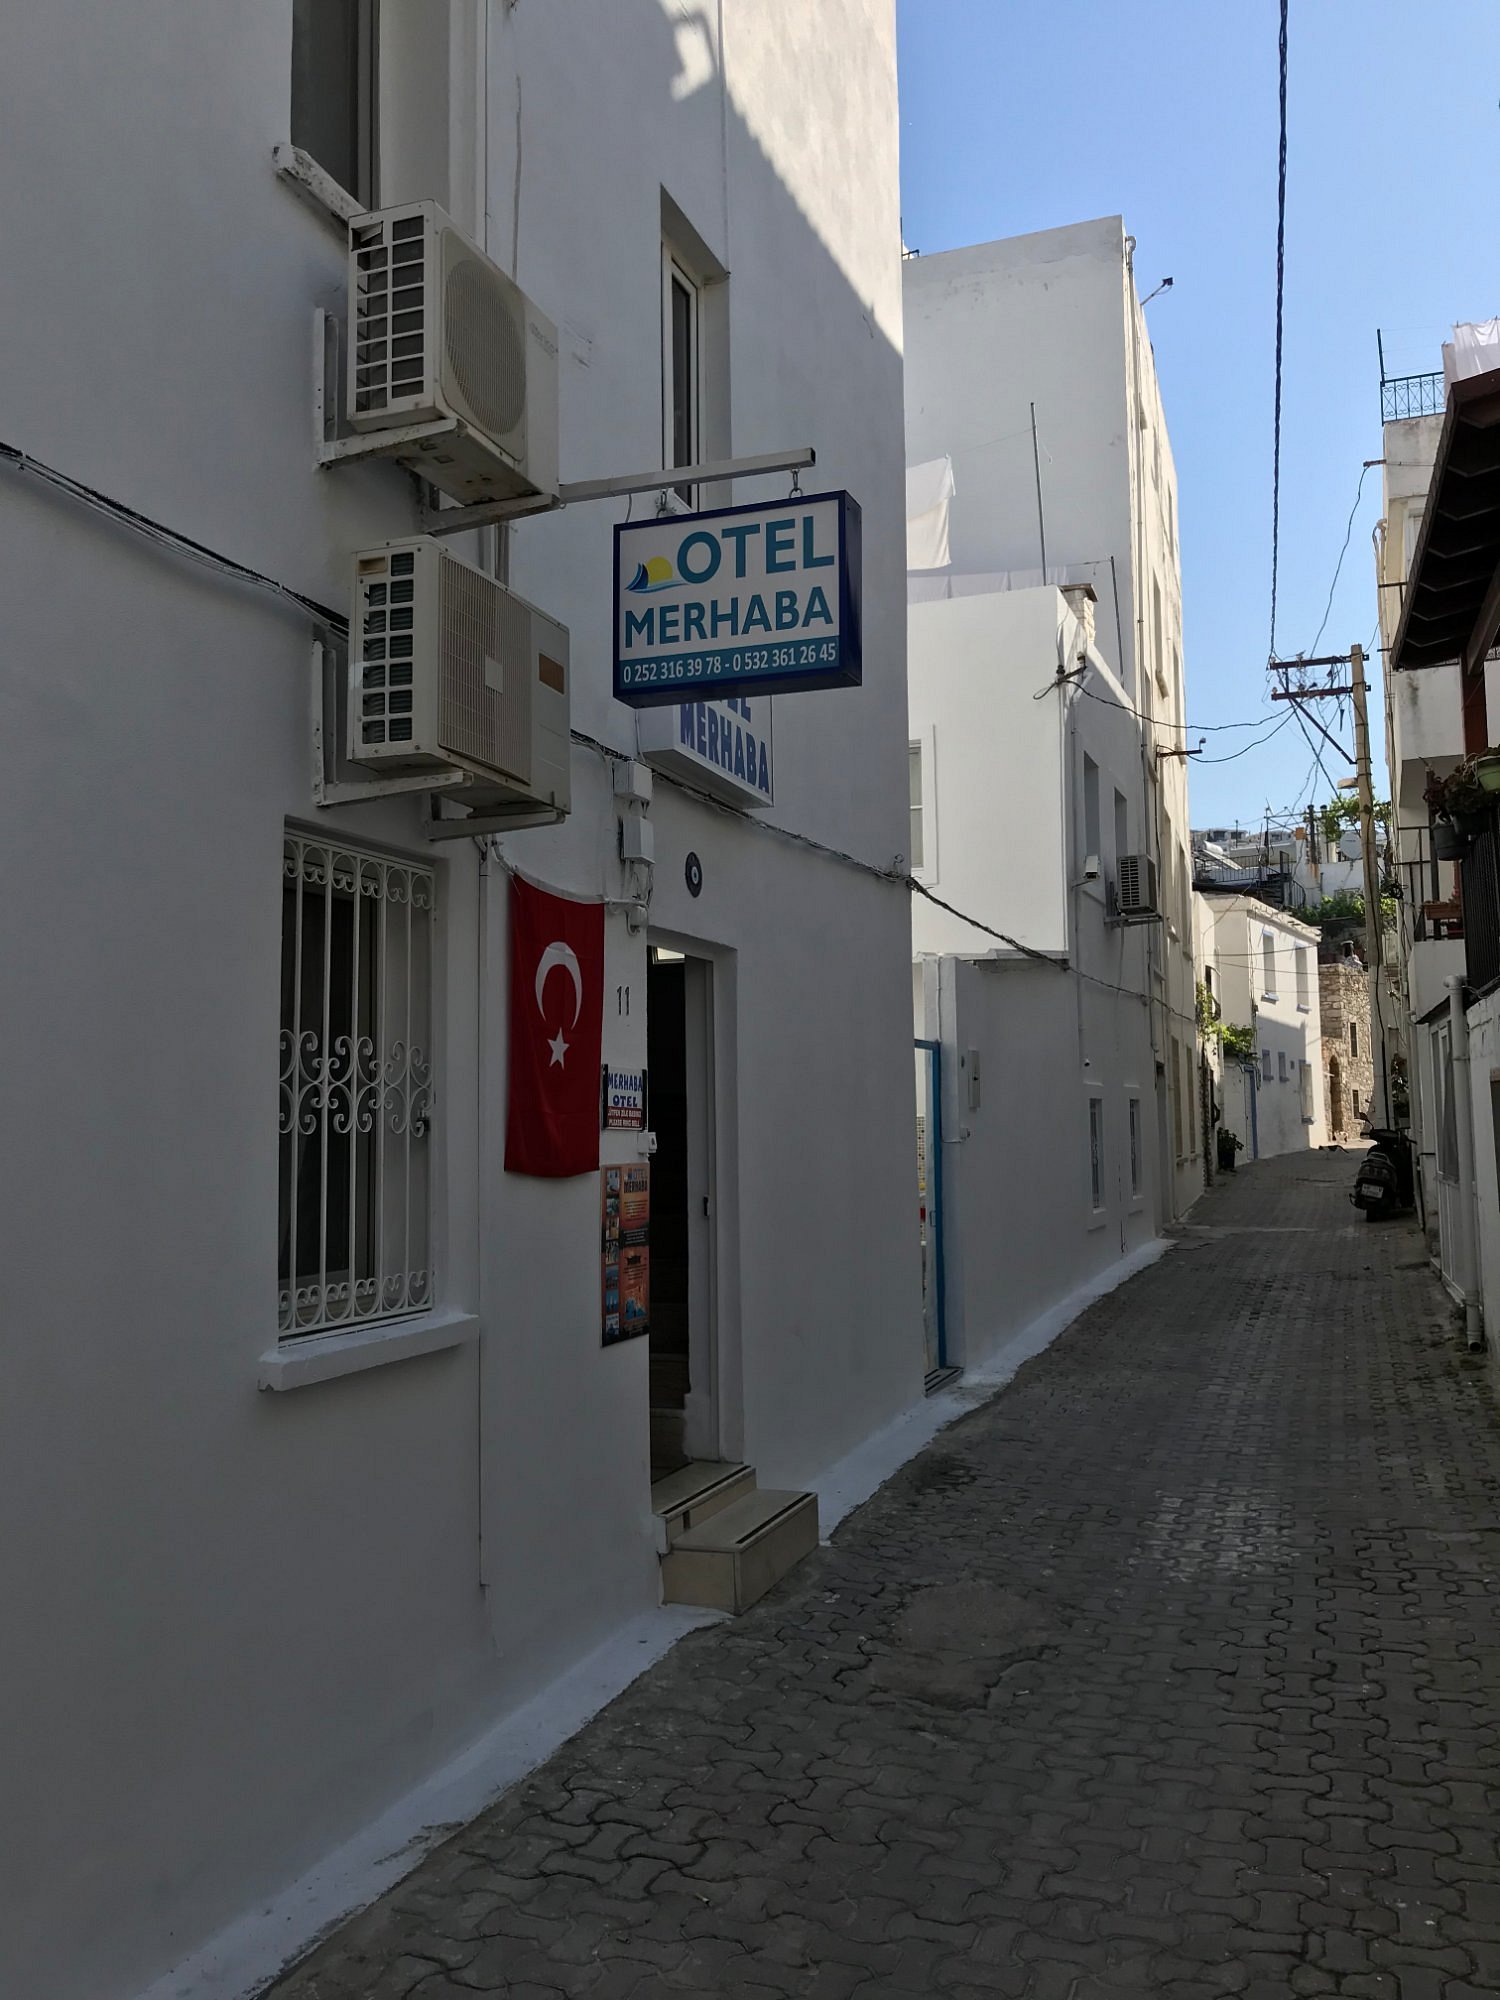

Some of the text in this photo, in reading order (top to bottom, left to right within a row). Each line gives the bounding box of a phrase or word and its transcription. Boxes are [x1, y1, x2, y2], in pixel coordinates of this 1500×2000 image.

[677, 515, 835, 585] OTEL
[625, 586, 833, 648] MERHABA
[623, 666, 632, 684] 0
[634, 664, 657, 682] 252
[660, 660, 684, 680] 316
[687, 658, 702, 676] 39
[706, 656, 722, 674] 78
[732, 654, 741, 672] 0
[744, 650, 769, 670] 532
[772, 647, 796, 667] 361
[799, 645, 817, 664] 26
[819, 642, 836, 661] 45
[680, 701, 770, 795] MERHABA
[616, 985, 630, 1016] 11
[608, 1073, 643, 1092] MERHABA
[612, 1094, 638, 1108] OTEL
[624, 1179, 648, 1194] MERHABA
